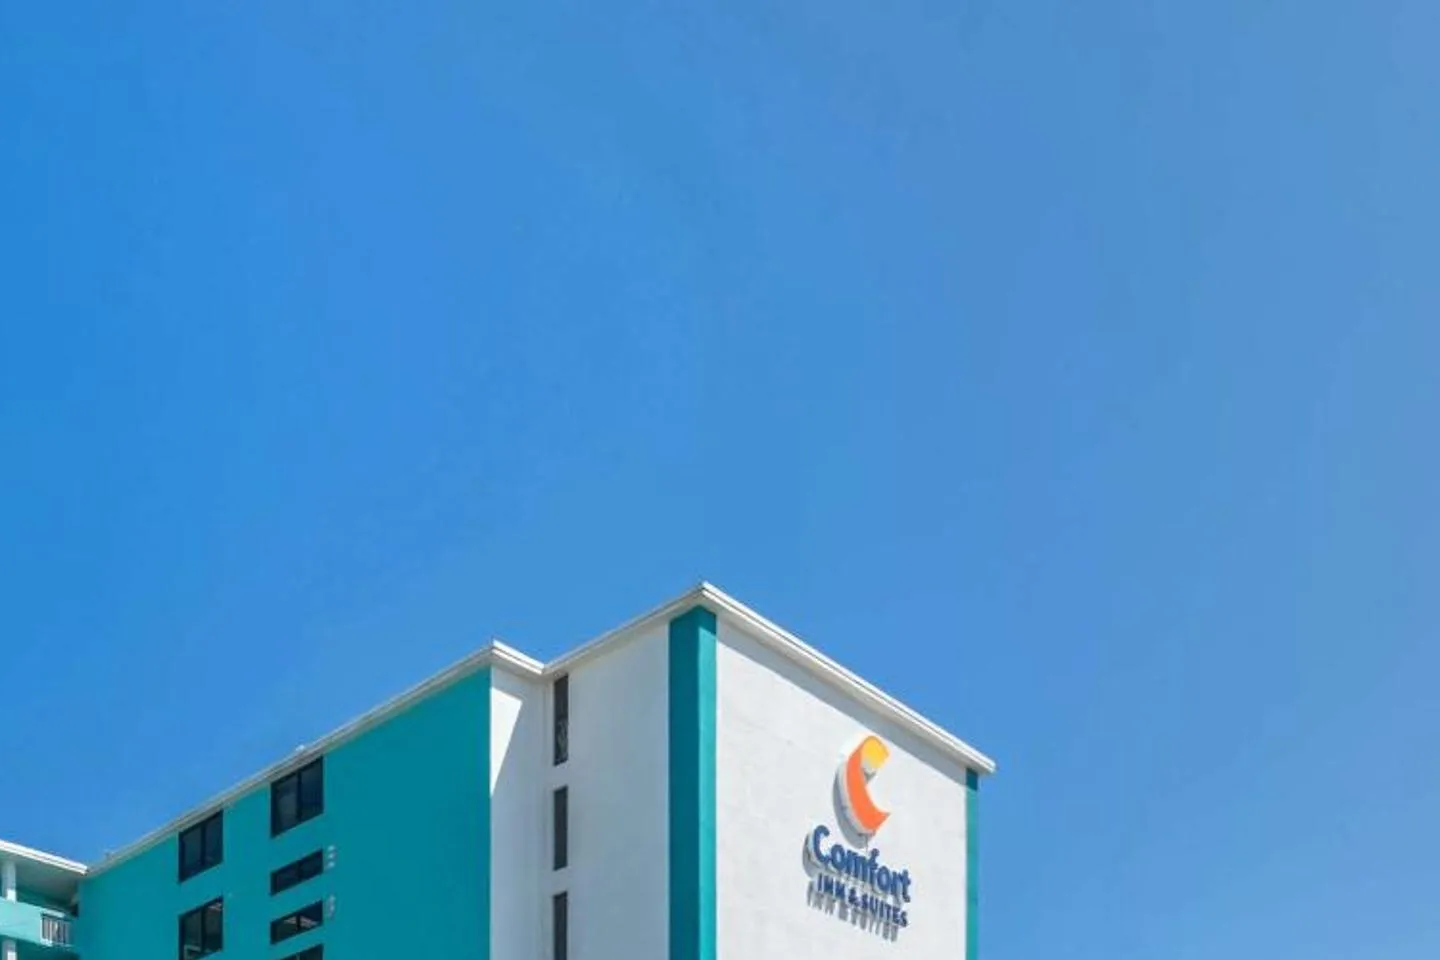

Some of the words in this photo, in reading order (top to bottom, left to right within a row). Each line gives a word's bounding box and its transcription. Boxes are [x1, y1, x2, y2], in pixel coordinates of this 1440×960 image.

[812, 824, 911, 903] Comfort
[817, 872, 846, 900] INN
[847, 886, 862, 907] &
[861, 893, 908, 928] SUITES
